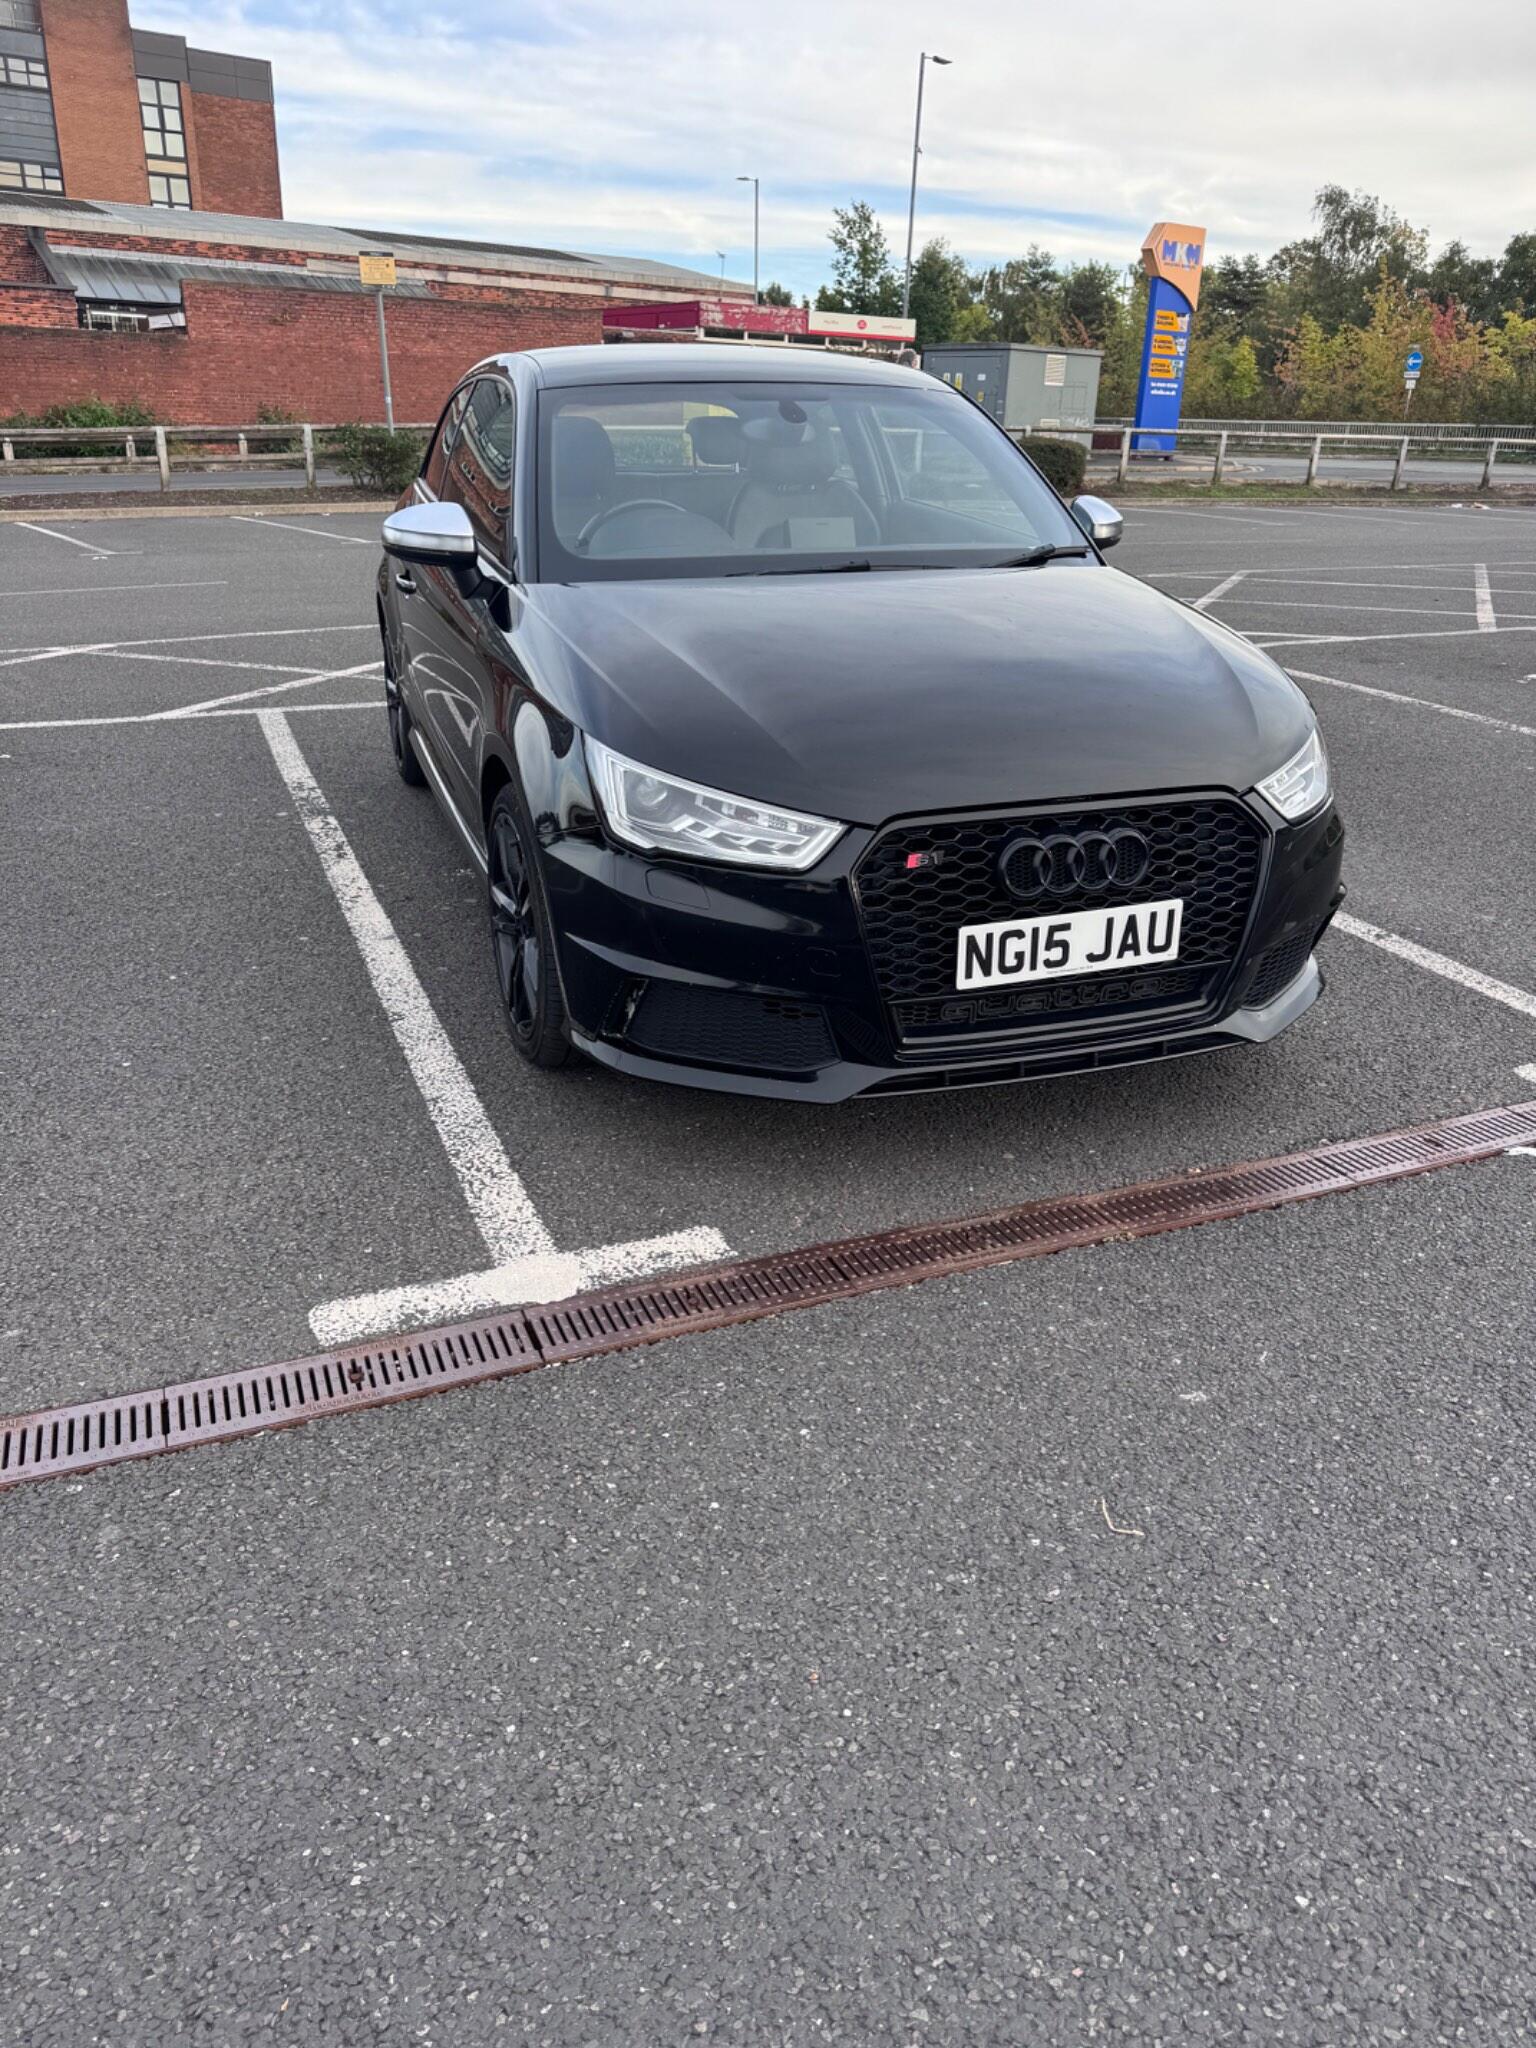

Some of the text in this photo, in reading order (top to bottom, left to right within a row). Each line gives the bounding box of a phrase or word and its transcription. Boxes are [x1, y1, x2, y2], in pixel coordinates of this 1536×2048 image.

[1162, 240, 1201, 265] MKM
[964, 908, 1176, 980] NG15 JAU
[941, 976, 1161, 1024] quattro
